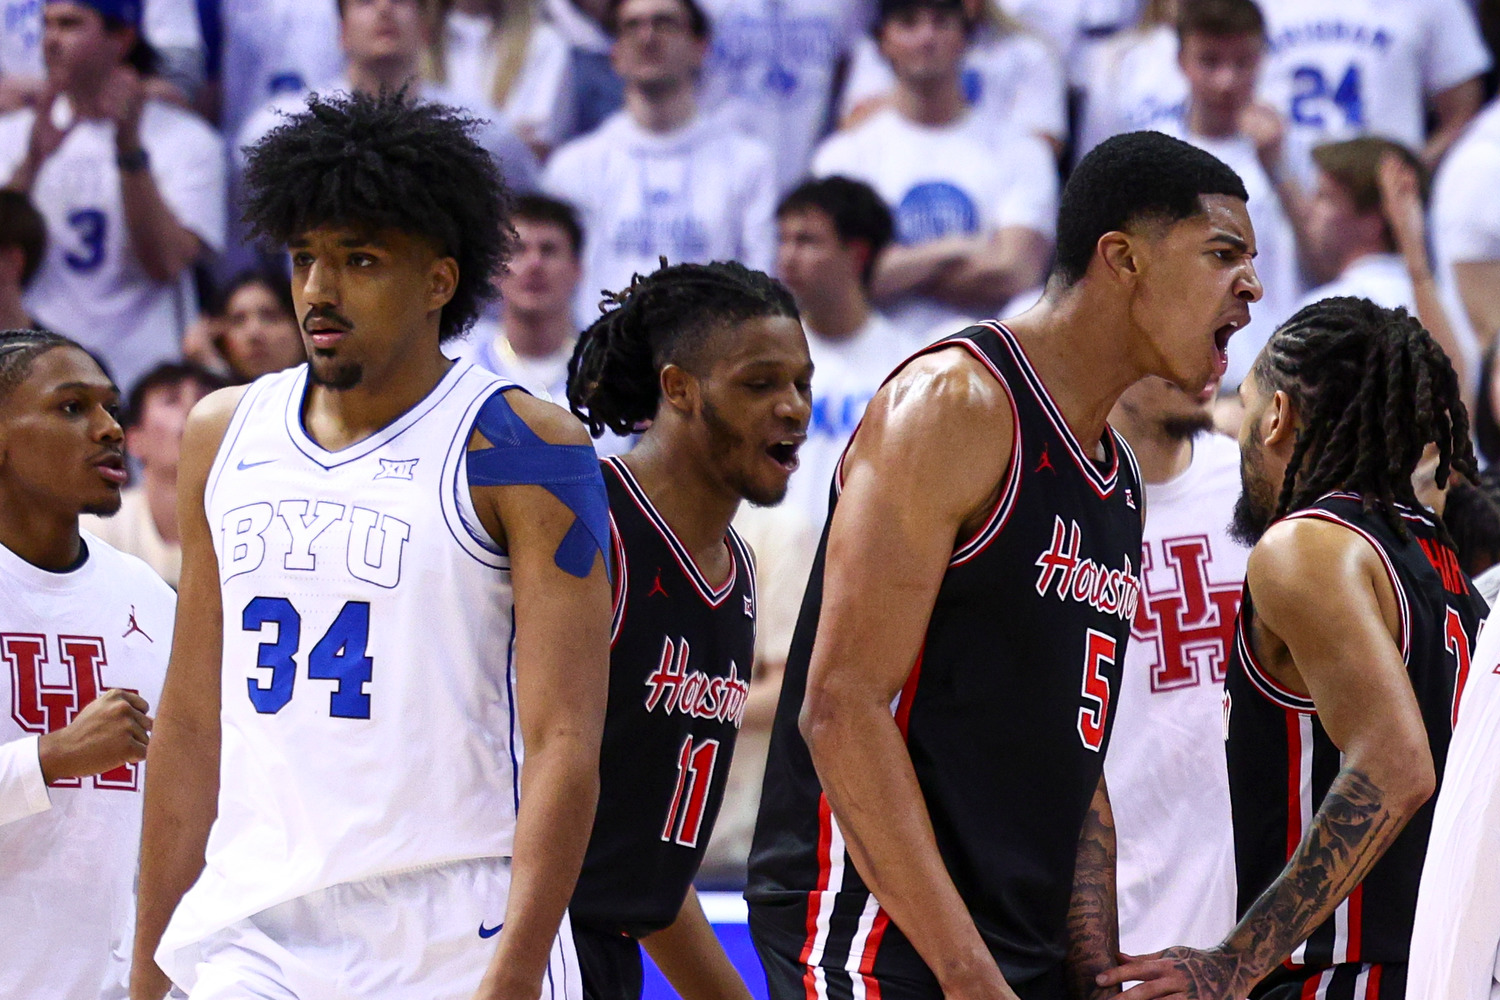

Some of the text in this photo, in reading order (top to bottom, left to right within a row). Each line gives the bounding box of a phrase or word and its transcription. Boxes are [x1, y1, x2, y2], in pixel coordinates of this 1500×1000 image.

[1290, 60, 1364, 128] 24
[64, 207, 107, 273] 3
[221, 499, 411, 589] BYU
[1035, 514, 1141, 622] Housto
[242, 596, 374, 720] 34
[1077, 627, 1117, 753] 5
[661, 733, 720, 849] 11
